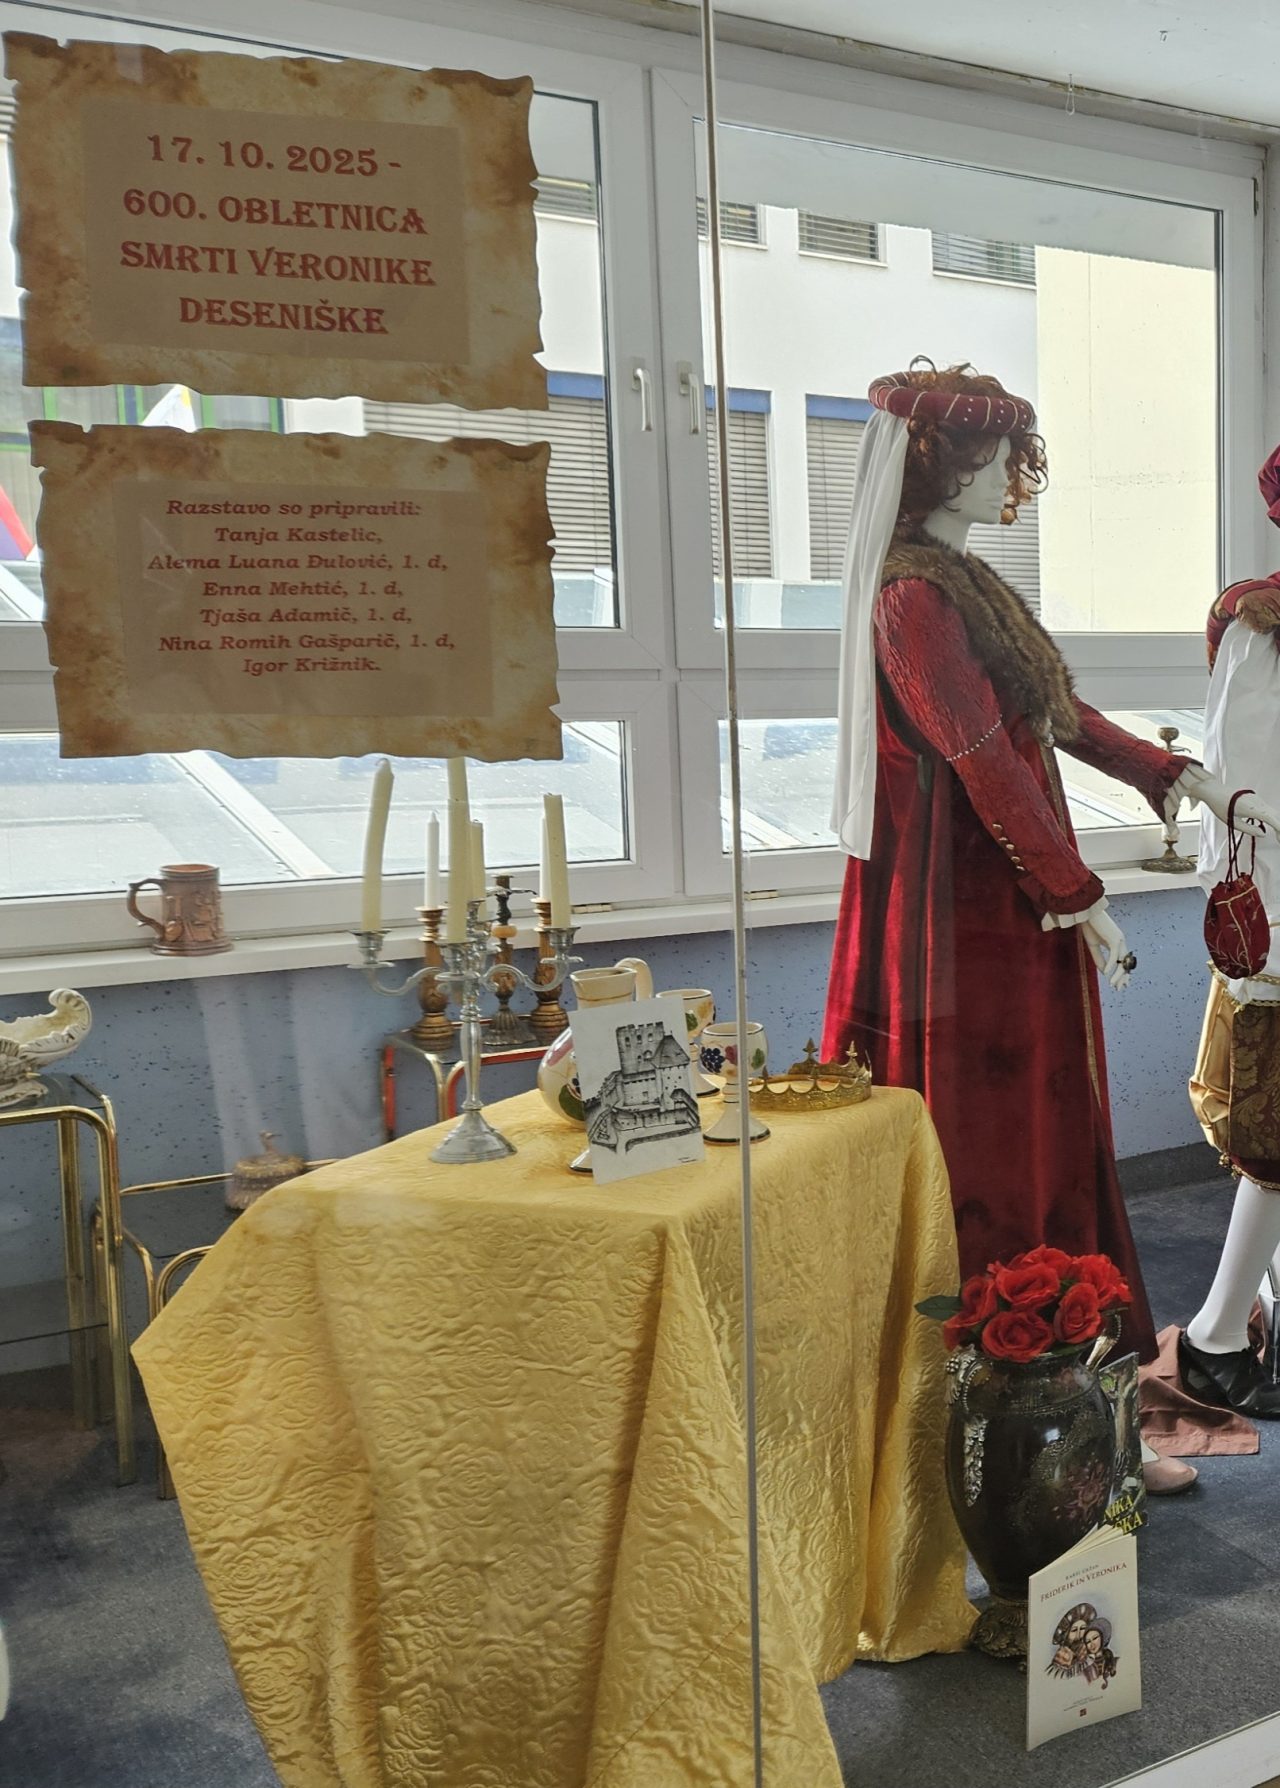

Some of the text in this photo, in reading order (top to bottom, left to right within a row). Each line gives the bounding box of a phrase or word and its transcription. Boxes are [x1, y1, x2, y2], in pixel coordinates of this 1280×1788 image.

[147, 135, 204, 164] 17.
[219, 141, 274, 169] 10.
[287, 146, 378, 176] 2025
[124, 189, 428, 234] 600. OBLETNICA
[120, 241, 436, 286] SMRTI VERONIKE
[180, 297, 388, 334] DESENIŠKE
[166, 500, 421, 519] Razstavo so pripravili:
[214, 528, 382, 545] Tanja Kastelic,
[148, 554, 448, 571] Alema Luana Đulović, 1. d,
[202, 580, 403, 598] Enna Mehtić, 1. d,
[199, 607, 412, 627] Tjaša Adamič, 1. d,
[159, 633, 455, 652] Nina Romih Gašparič, 1. d,
[243, 657, 381, 676] Igor Križnik.
[1086, 1562, 1127, 1581] VERONIKA
